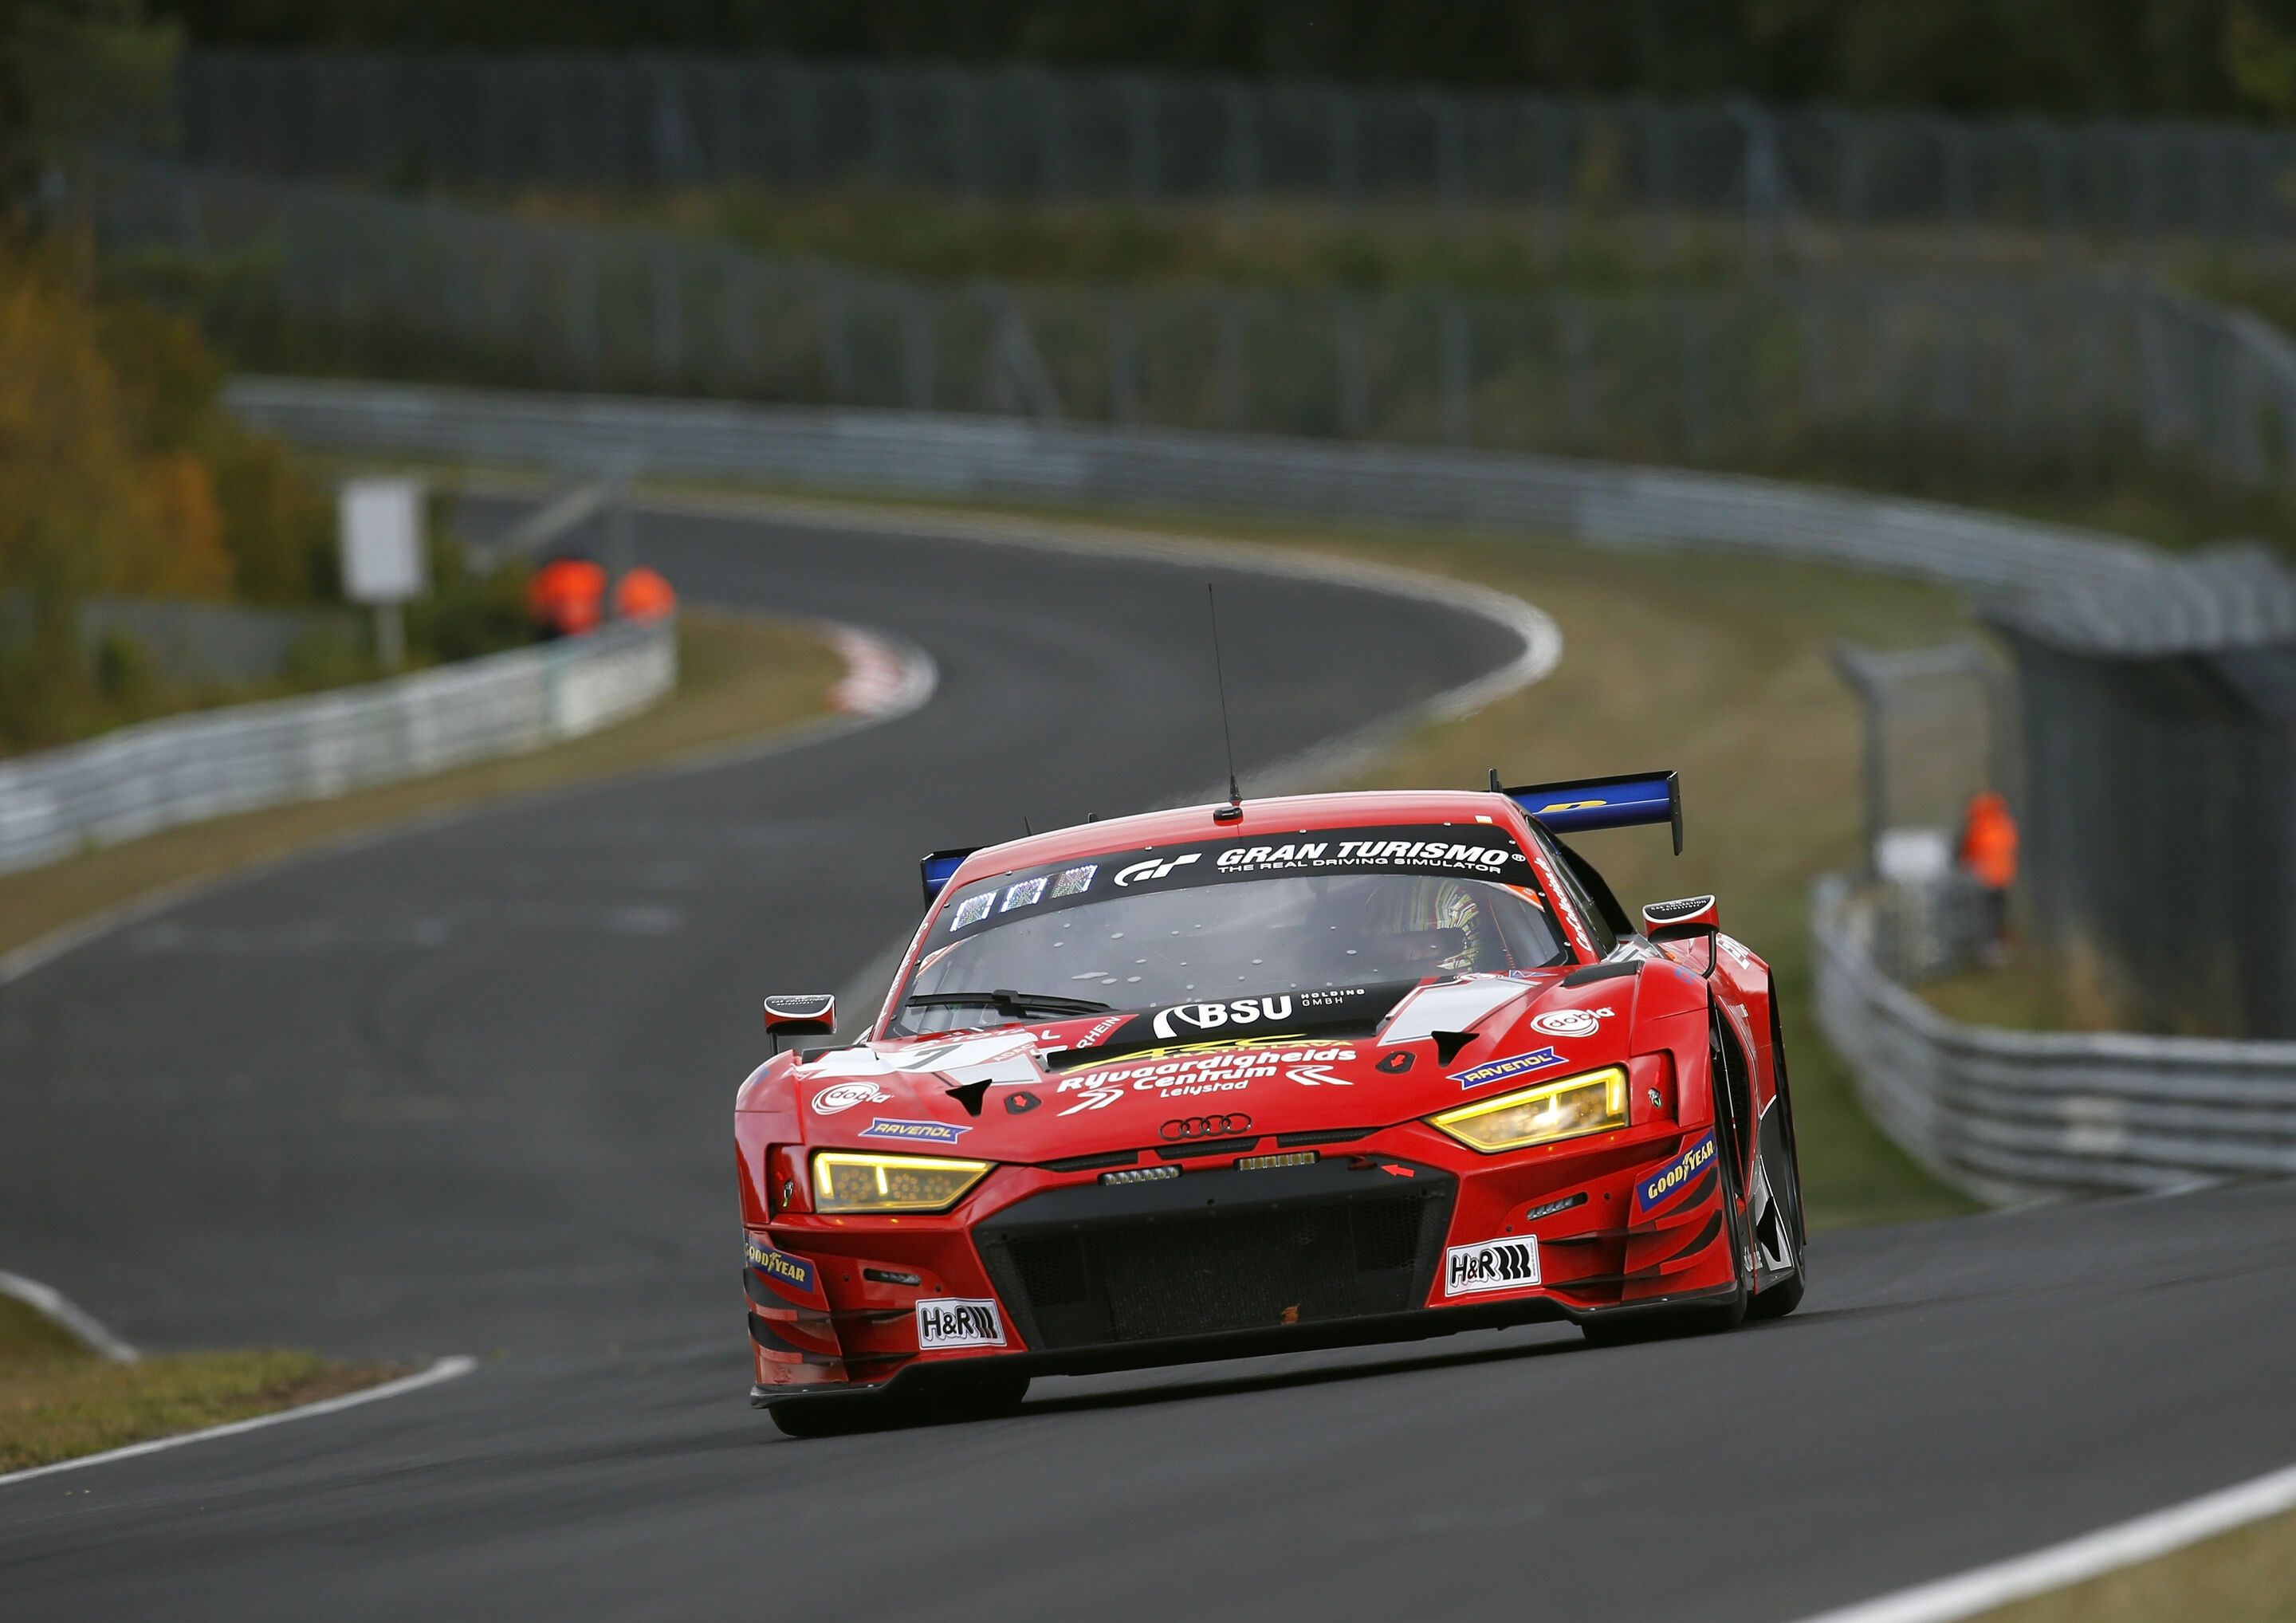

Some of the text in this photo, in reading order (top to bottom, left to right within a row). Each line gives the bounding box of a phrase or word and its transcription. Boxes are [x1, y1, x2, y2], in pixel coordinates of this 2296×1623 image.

[1216, 843, 1328, 867] GRAN
[1260, 860, 1307, 870] REAL
[1312, 858, 1389, 867] DRIVING
[1394, 858, 1501, 874] SIMULATOR
[1300, 988, 1366, 1000] HOLDING
[1301, 997, 1344, 1007] GMBH
[1198, 995, 1293, 1029] BSU
[1549, 1007, 1616, 1028] dobla
[1076, 1016, 1121, 1049] RHEIN
[1133, 1065, 1277, 1091] Centrum
[1464, 1052, 1553, 1083] RAVENOL
[1159, 1080, 1249, 1098] Lelystad
[875, 1123, 953, 1138] RAVENOL
[1451, 1249, 1498, 1285] H&R
[922, 1307, 976, 1339] H&R
